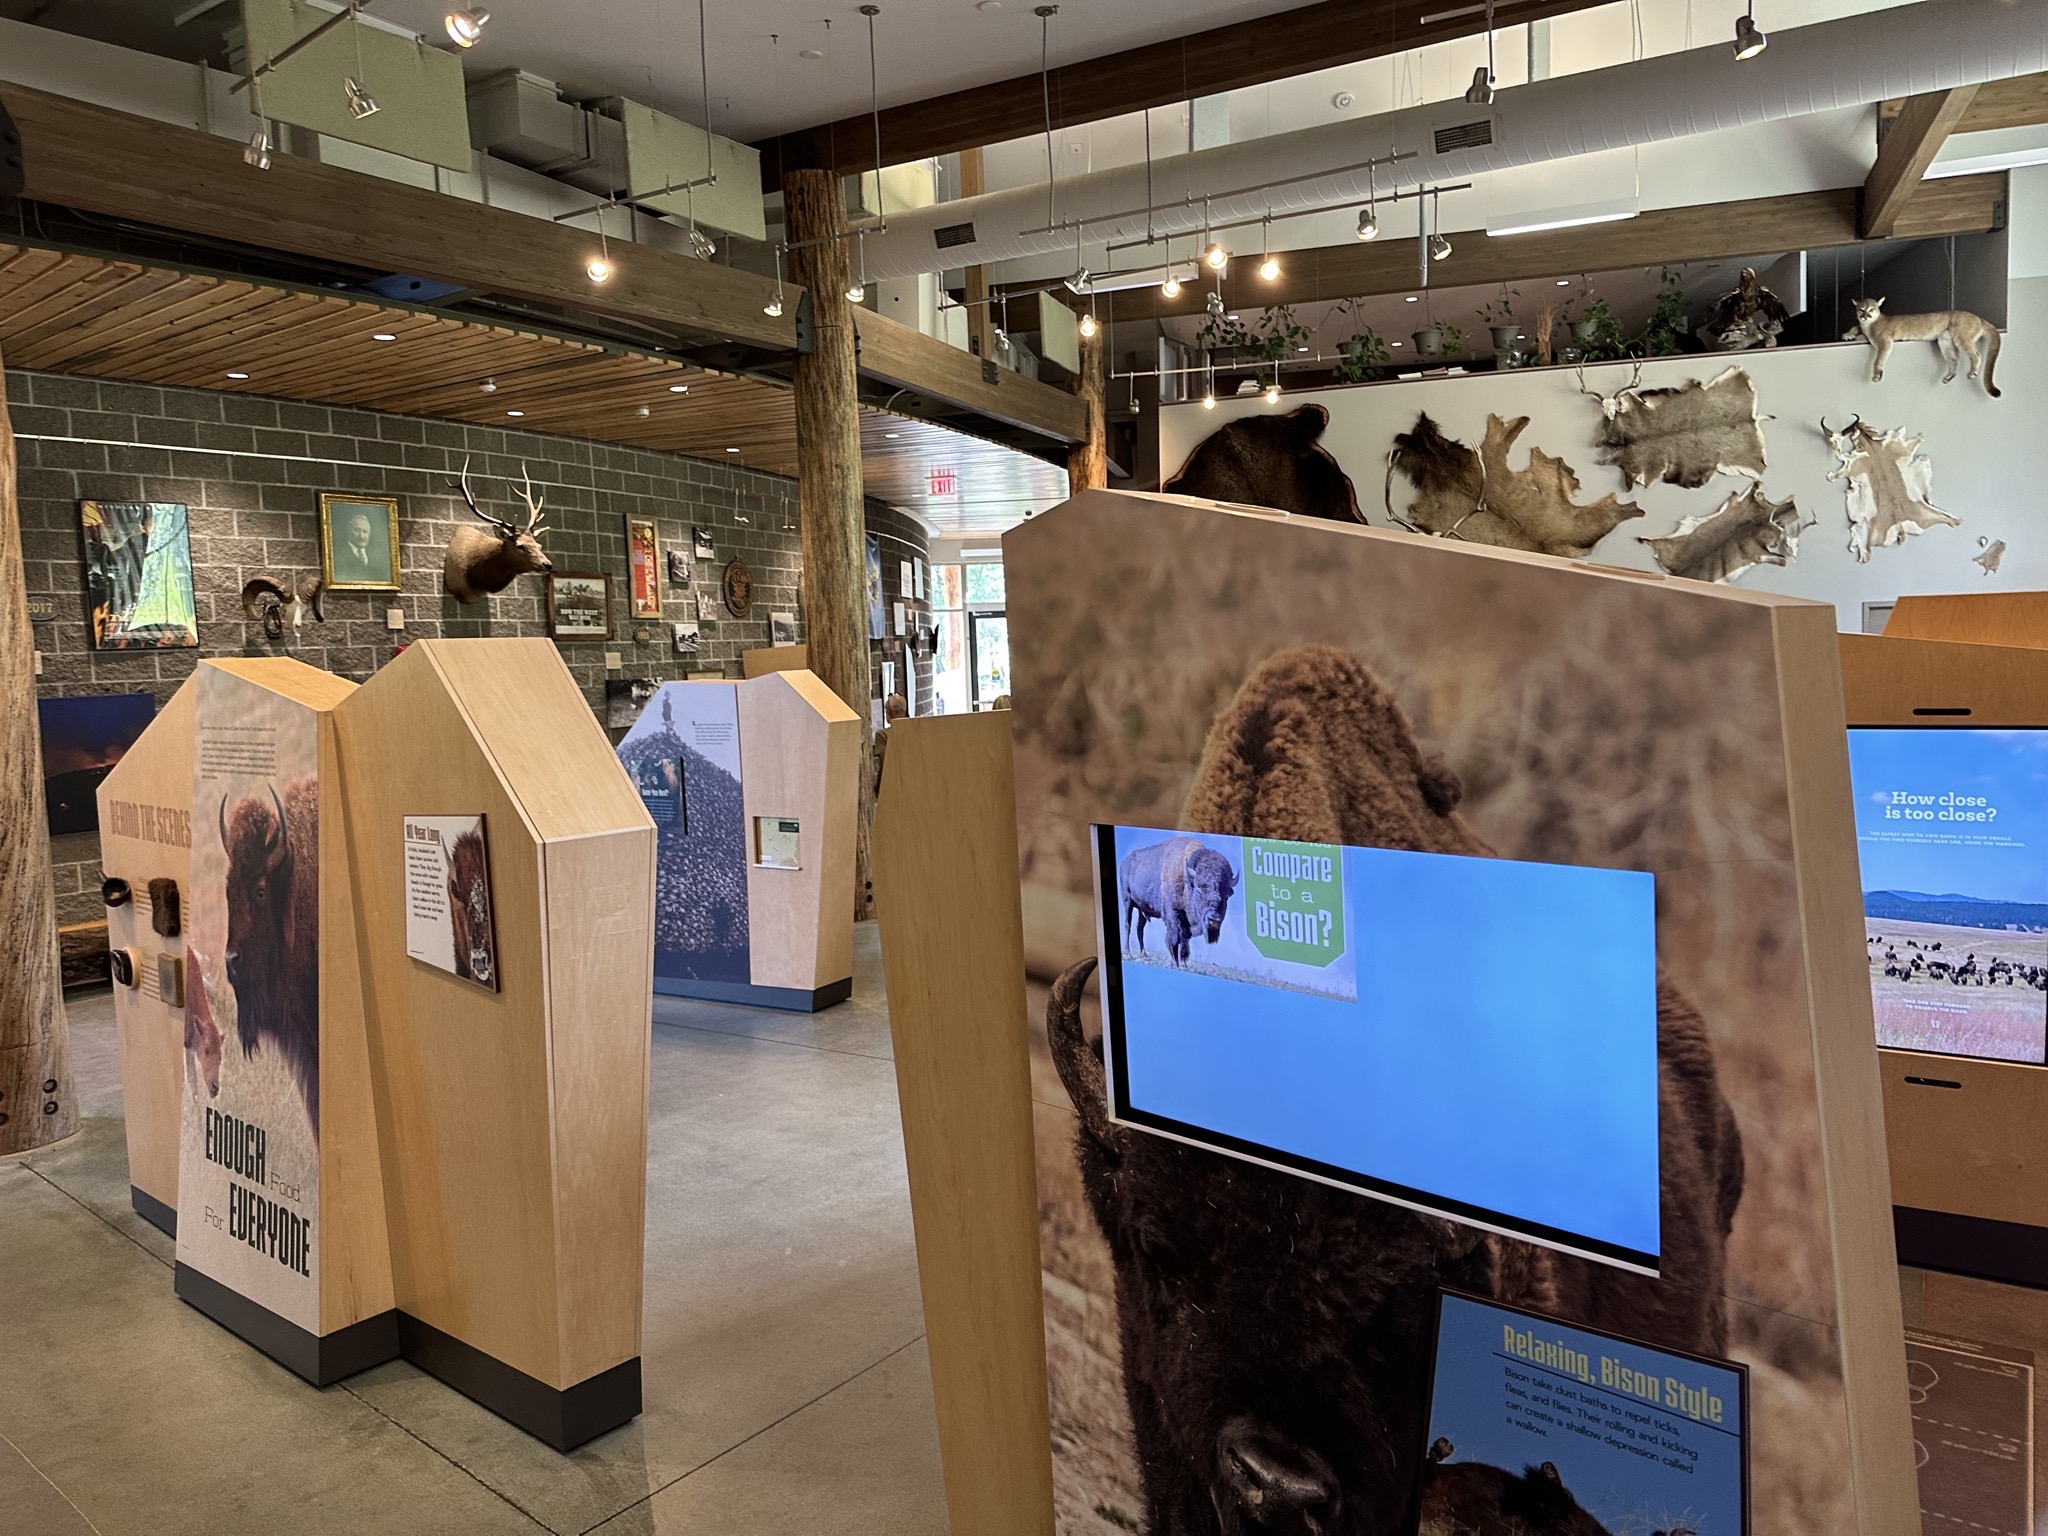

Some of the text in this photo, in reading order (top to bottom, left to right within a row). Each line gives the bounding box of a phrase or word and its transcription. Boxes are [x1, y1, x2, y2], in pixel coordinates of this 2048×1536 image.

[932, 479, 951, 494] EXIT
[27, 603, 53, 613] 2017
[1885, 806, 1997, 822] is too close?
[1891, 791, 1987, 807] How close
[110, 800, 192, 849] BEHIND THE SCENES
[1251, 846, 1332, 883] Compare
[1271, 884, 1314, 903] to a
[1256, 901, 1332, 947] Bison?
[205, 1106, 302, 1204] ENOUGH Food
[204, 1182, 310, 1278] For EVERYONE
[1504, 1325, 1722, 1423] Relaxing, Bison Style
[1505, 1367, 1680, 1437] Bison take dust baths to repel ticks,
[1505, 1383, 1698, 1461] fleas, and flies. Their rolling and kicking
[1506, 1401, 1522, 1412] can
[1525, 1408, 1554, 1423] create
[1566, 1421, 1602, 1439] shallow
[1605, 1435, 1659, 1461] depression
[1663, 1457, 1693, 1474] called
[1515, 1420, 1548, 1437] wallow.
